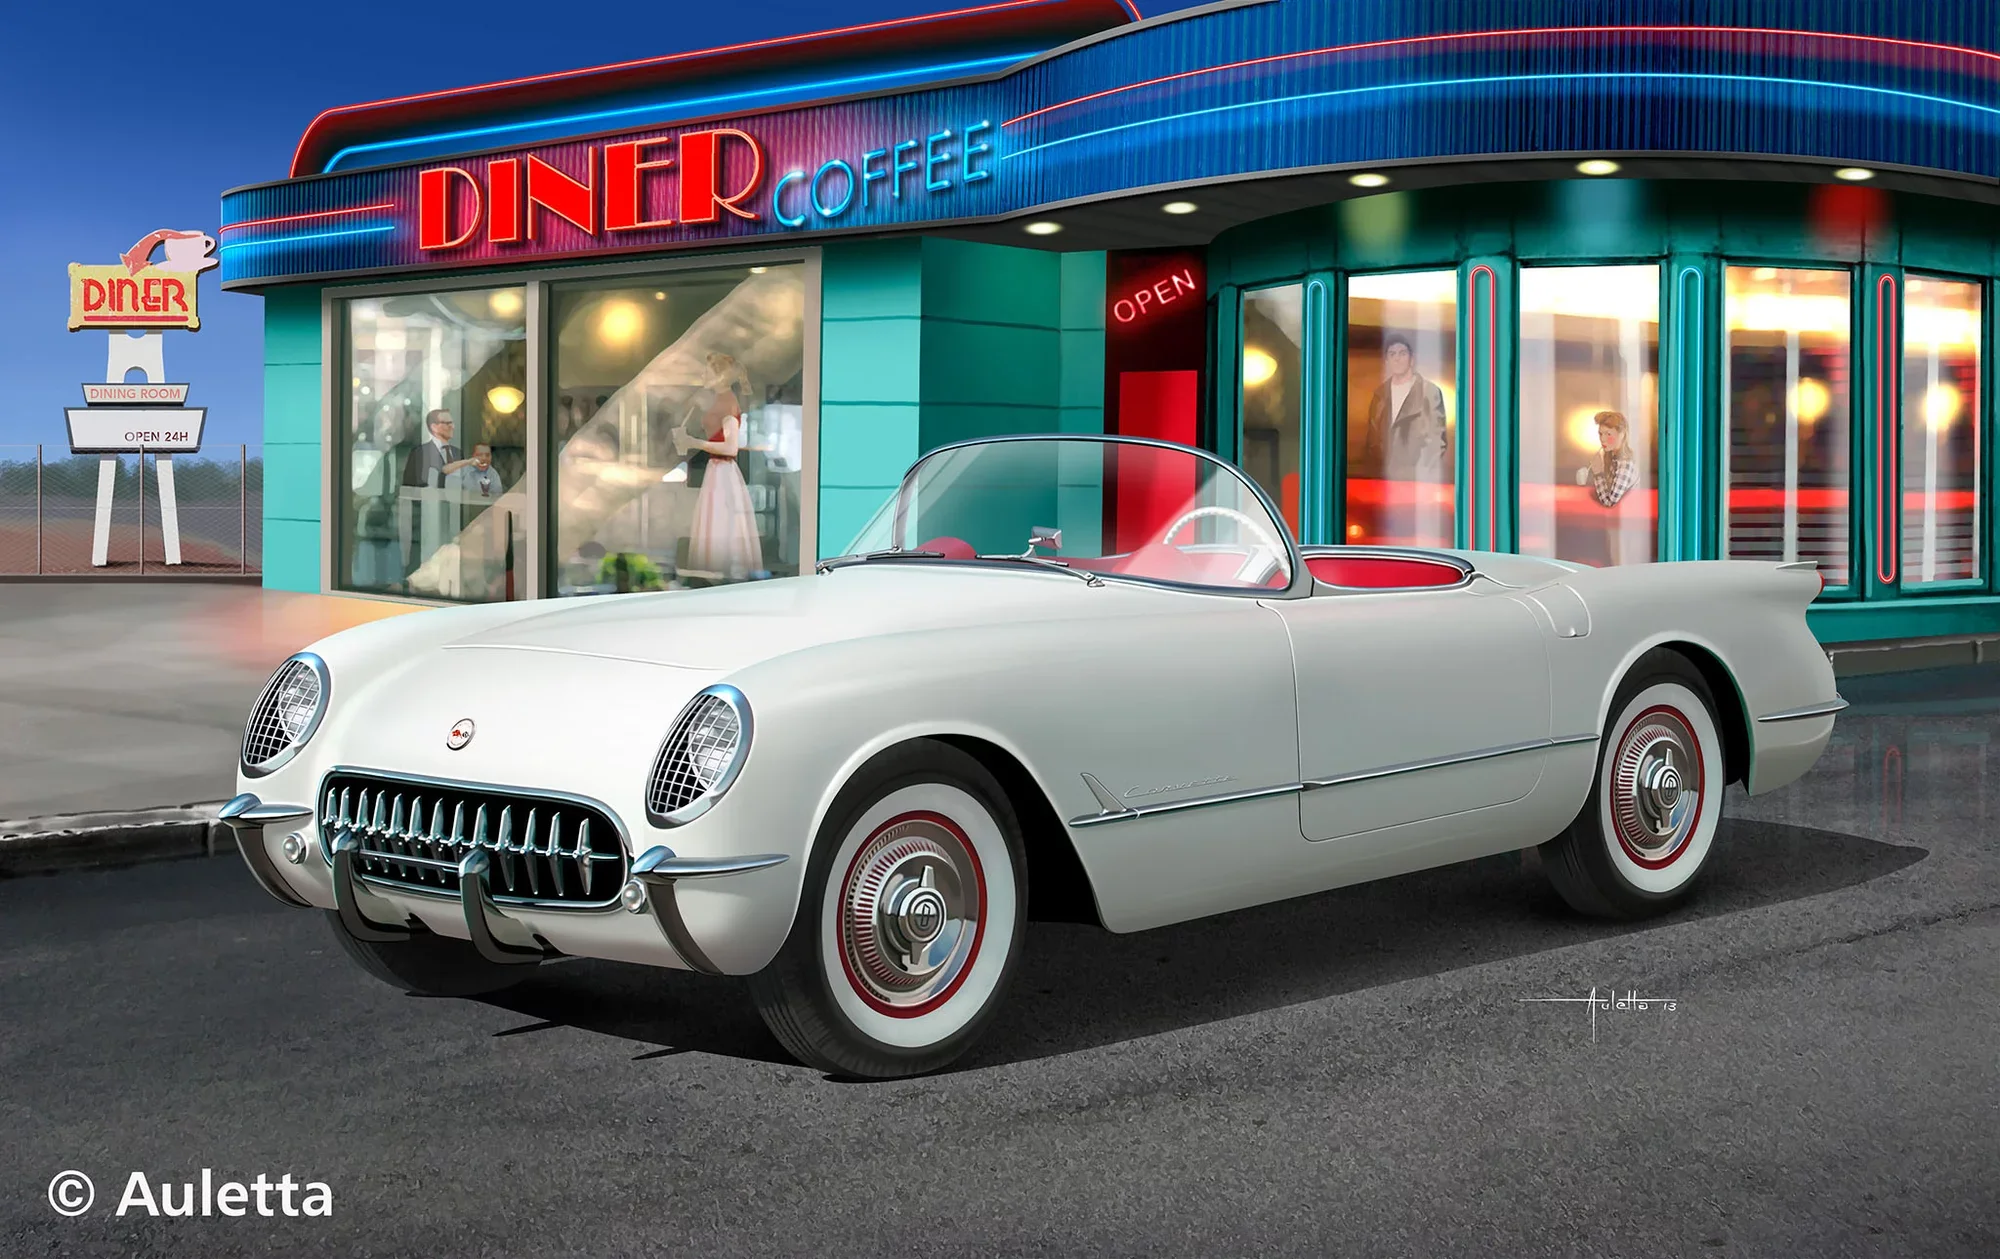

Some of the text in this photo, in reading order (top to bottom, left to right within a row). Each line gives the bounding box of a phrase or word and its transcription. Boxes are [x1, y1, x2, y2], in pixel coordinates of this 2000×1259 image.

[419, 128, 765, 250] DINER
[773, 120, 990, 228] COFFEE
[82, 278, 189, 312] DINER
[1113, 268, 1196, 322] OPEN
[90, 388, 181, 399] DINING ROOM
[124, 431, 189, 442] OPEN 24H
